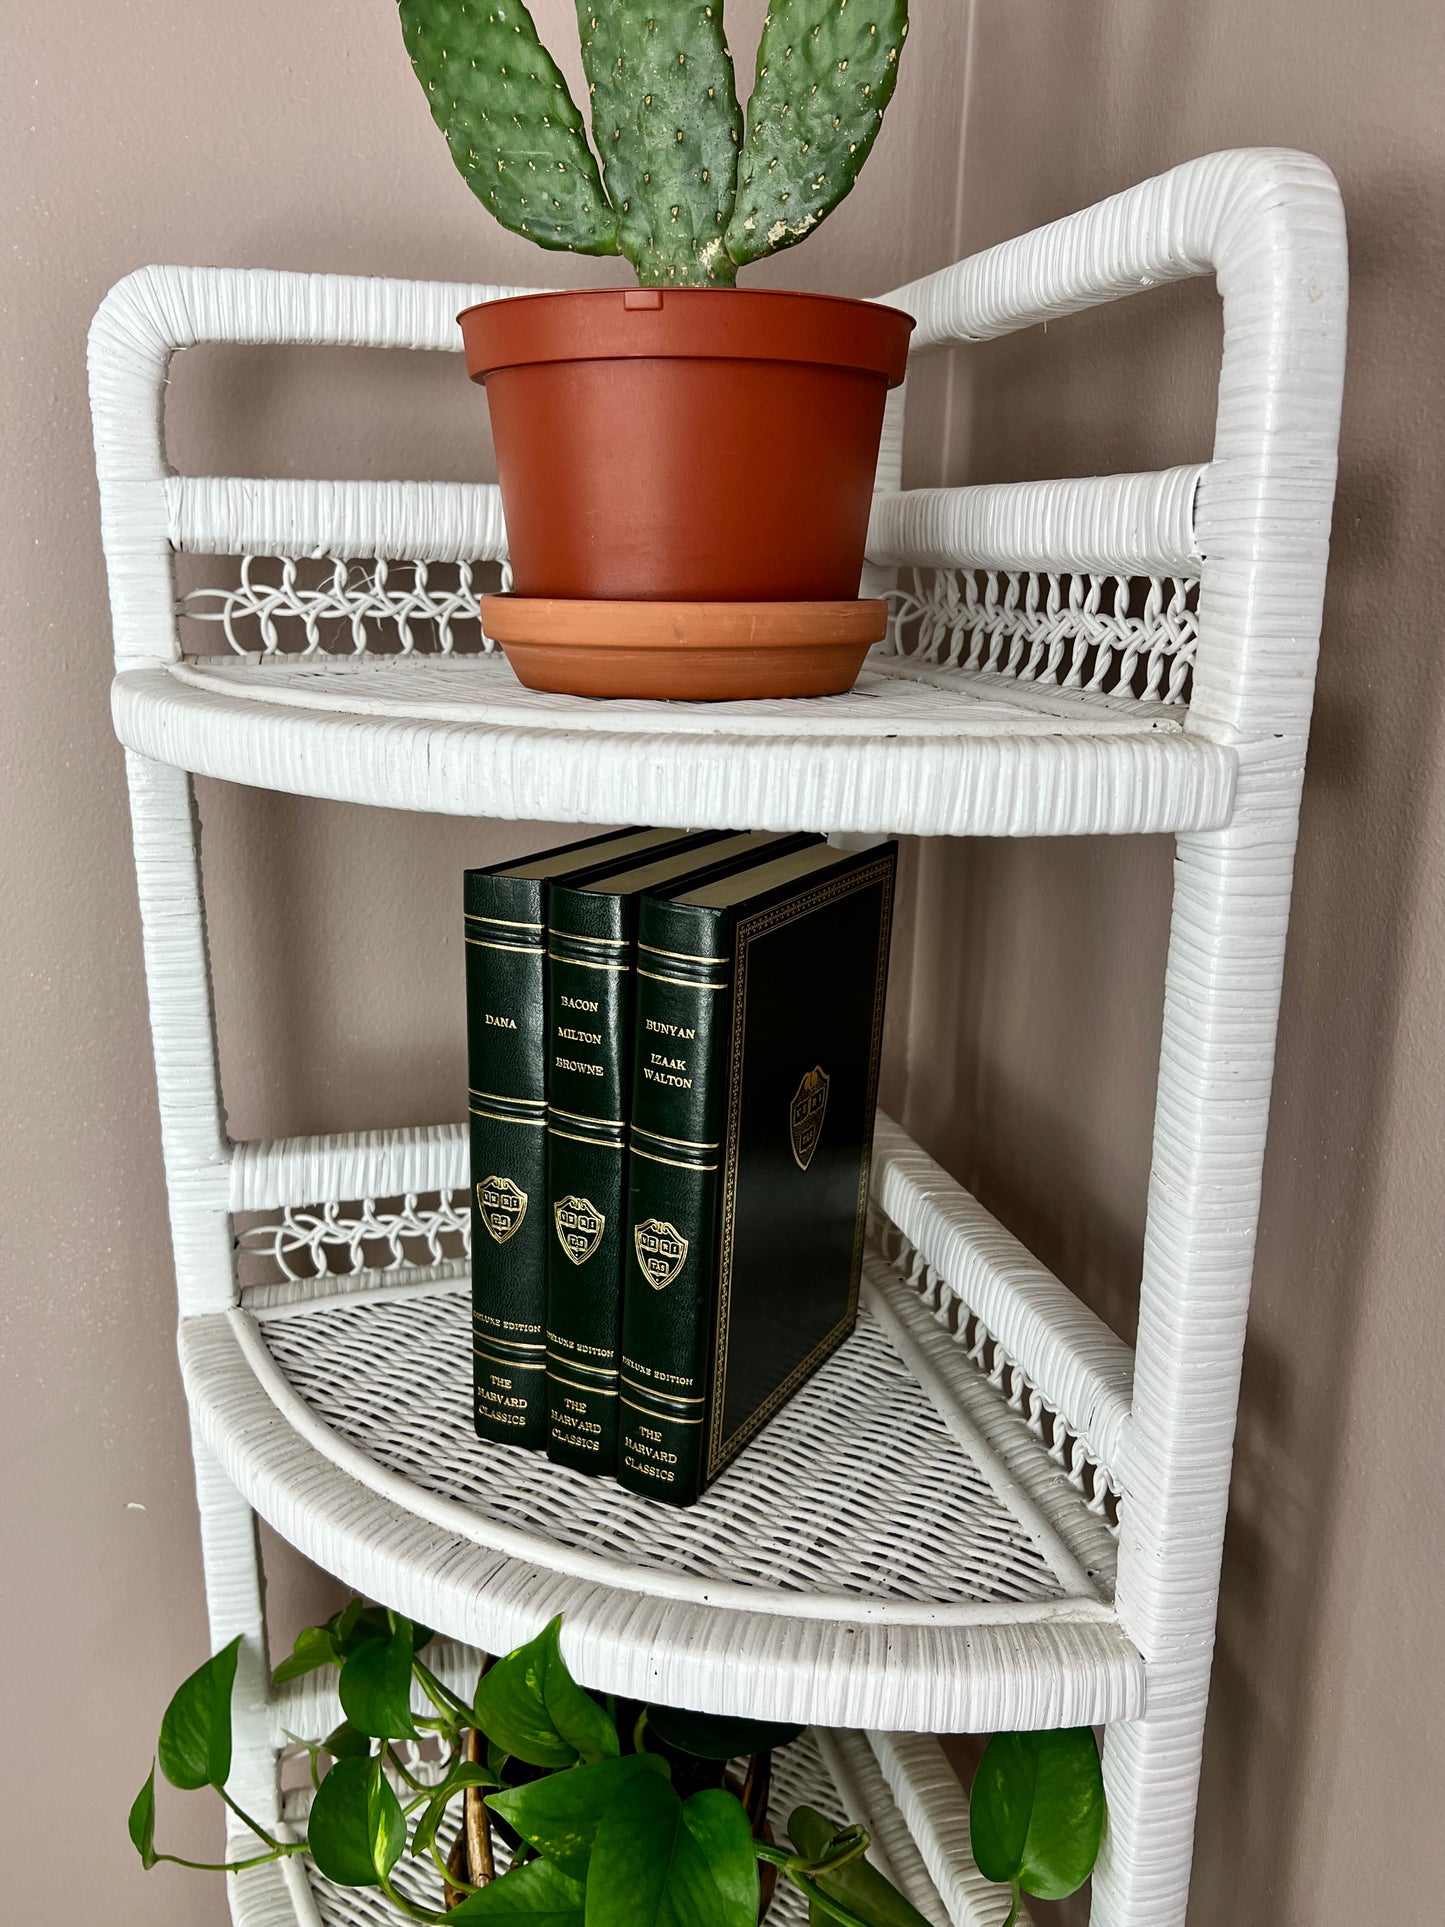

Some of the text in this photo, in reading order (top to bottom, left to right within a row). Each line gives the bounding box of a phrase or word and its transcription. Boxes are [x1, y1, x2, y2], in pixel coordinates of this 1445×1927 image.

[561, 996, 599, 1012] BACON
[485, 1014, 517, 1029] DANA
[646, 1018, 695, 1039] BUNYAN
[558, 1027, 602, 1045] MILTON
[556, 1057, 604, 1076] BROWNE
[651, 1053, 687, 1071] IZAAK
[643, 1068, 692, 1089] WALTON
[503, 1321, 541, 1332] EDITION
[576, 1343, 614, 1358] EDITION
[622, 1355, 694, 1386] DELUXE EDITION
[490, 1374, 512, 1390] THE
[477, 1386, 528, 1409] HARVARD
[564, 1398, 587, 1414] THE
[478, 1404, 526, 1426] CLASSICS
[551, 1409, 602, 1434] HARVARD
[551, 1428, 600, 1451] CLASSICS
[639, 1426, 663, 1442] THE
[625, 1436, 678, 1464] HARVARD
[625, 1456, 675, 1482] CLASSICS
